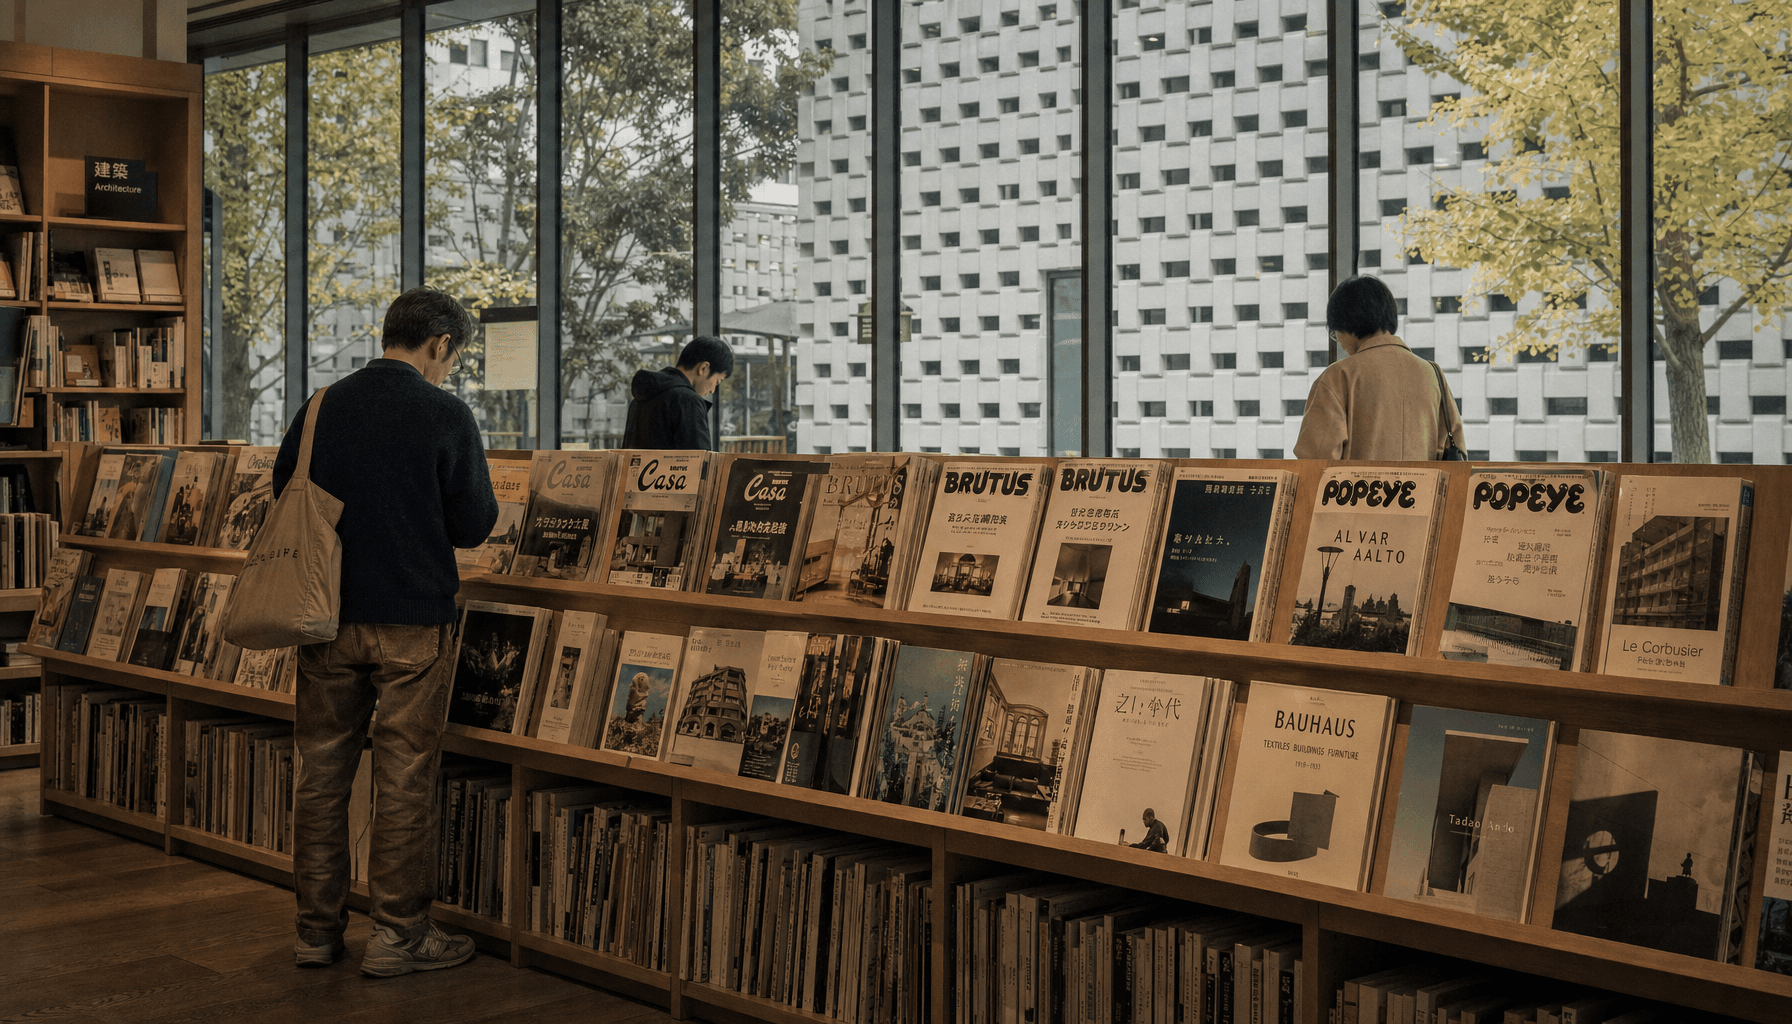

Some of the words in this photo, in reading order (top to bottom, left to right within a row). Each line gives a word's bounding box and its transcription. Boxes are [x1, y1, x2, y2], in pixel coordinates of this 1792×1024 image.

[94, 161, 129, 181] 建築
[94, 182, 142, 195] Architecture
[546, 459, 591, 490] Casa
[637, 459, 688, 492] Casa
[743, 473, 788, 502] Casa
[944, 470, 1034, 497] BRUTUS
[1060, 466, 1152, 494] BRUTUS
[1321, 479, 1418, 509] POPEYE
[1472, 481, 1586, 515] POPEYE
[1333, 529, 1390, 546] ALVAR
[1352, 549, 1406, 565] AALTO
[1622, 638, 1638, 653] Le
[1641, 639, 1705, 659] Corbusier
[1273, 709, 1357, 739] BAUHAUS
[1263, 739, 1291, 751] TEXTILES
[1448, 812, 1482, 829] Tadao
[1486, 818, 1516, 834] Ando
